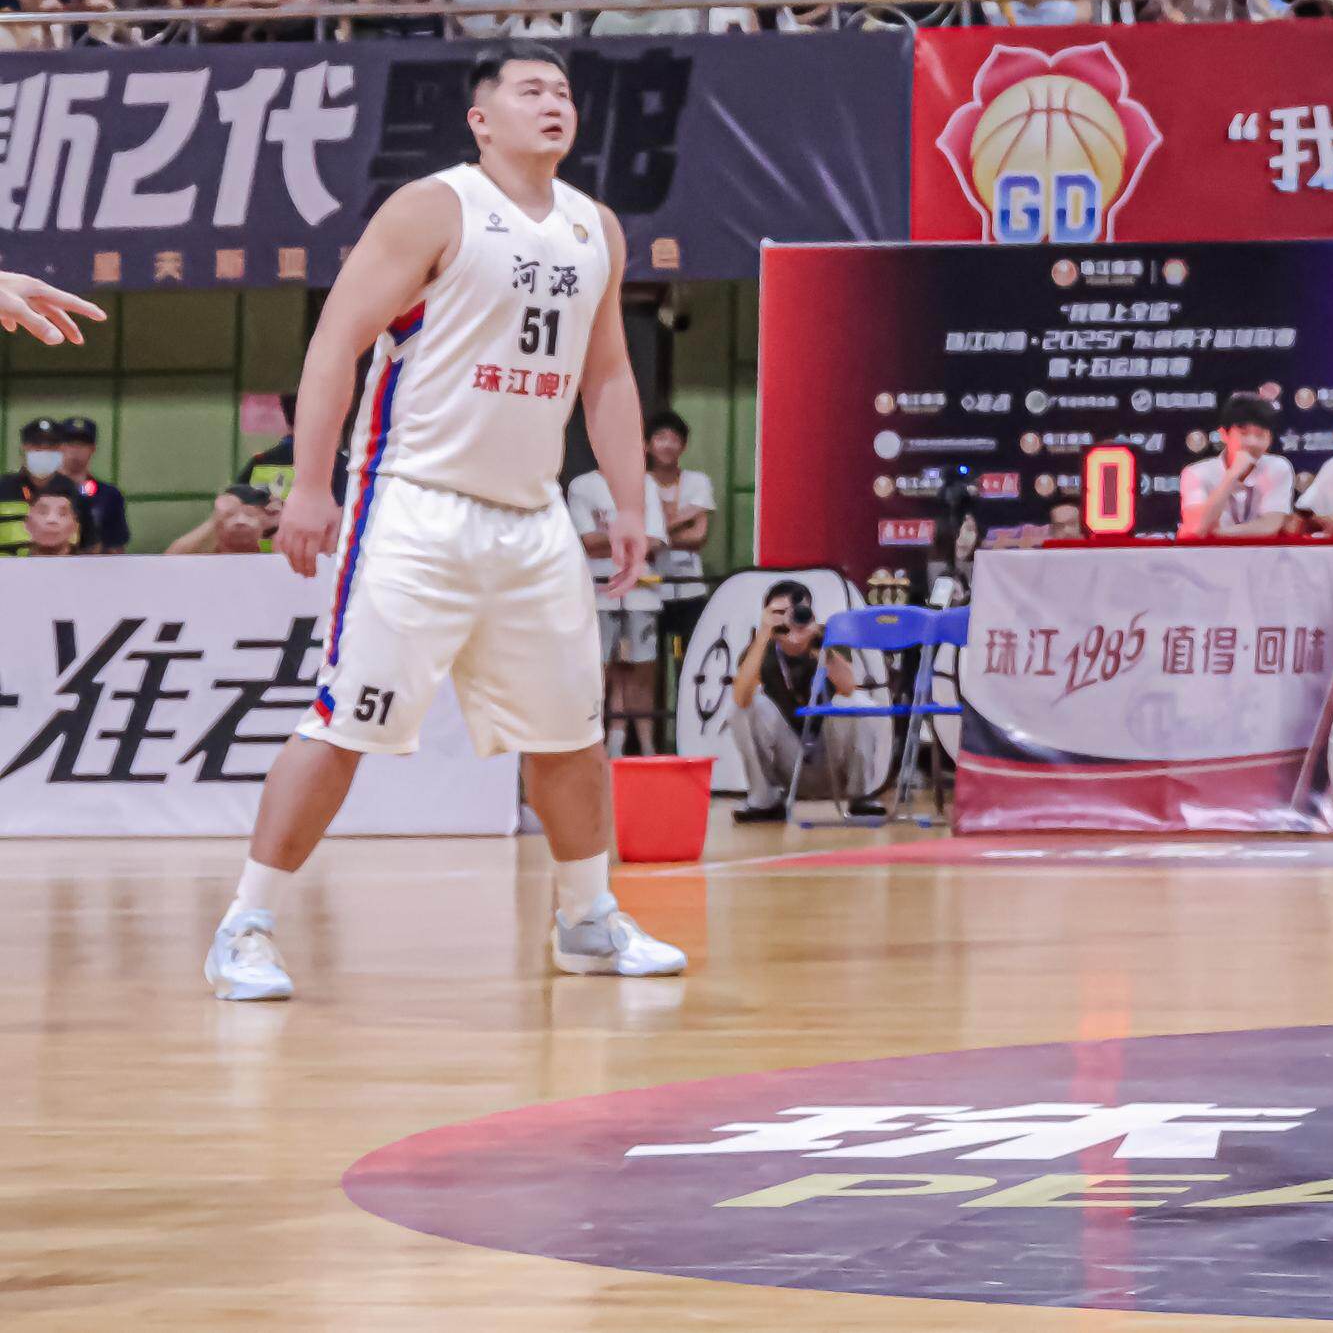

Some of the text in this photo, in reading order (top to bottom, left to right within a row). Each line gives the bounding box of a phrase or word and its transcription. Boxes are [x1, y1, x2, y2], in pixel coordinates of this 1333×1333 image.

[993, 172, 1104, 243] GD
[512, 254, 579, 298] 河源
[518, 306, 560, 357] 51
[1085, 446, 1136, 533] 0
[0, 617, 324, 784] 准者
[353, 685, 396, 726] 51
